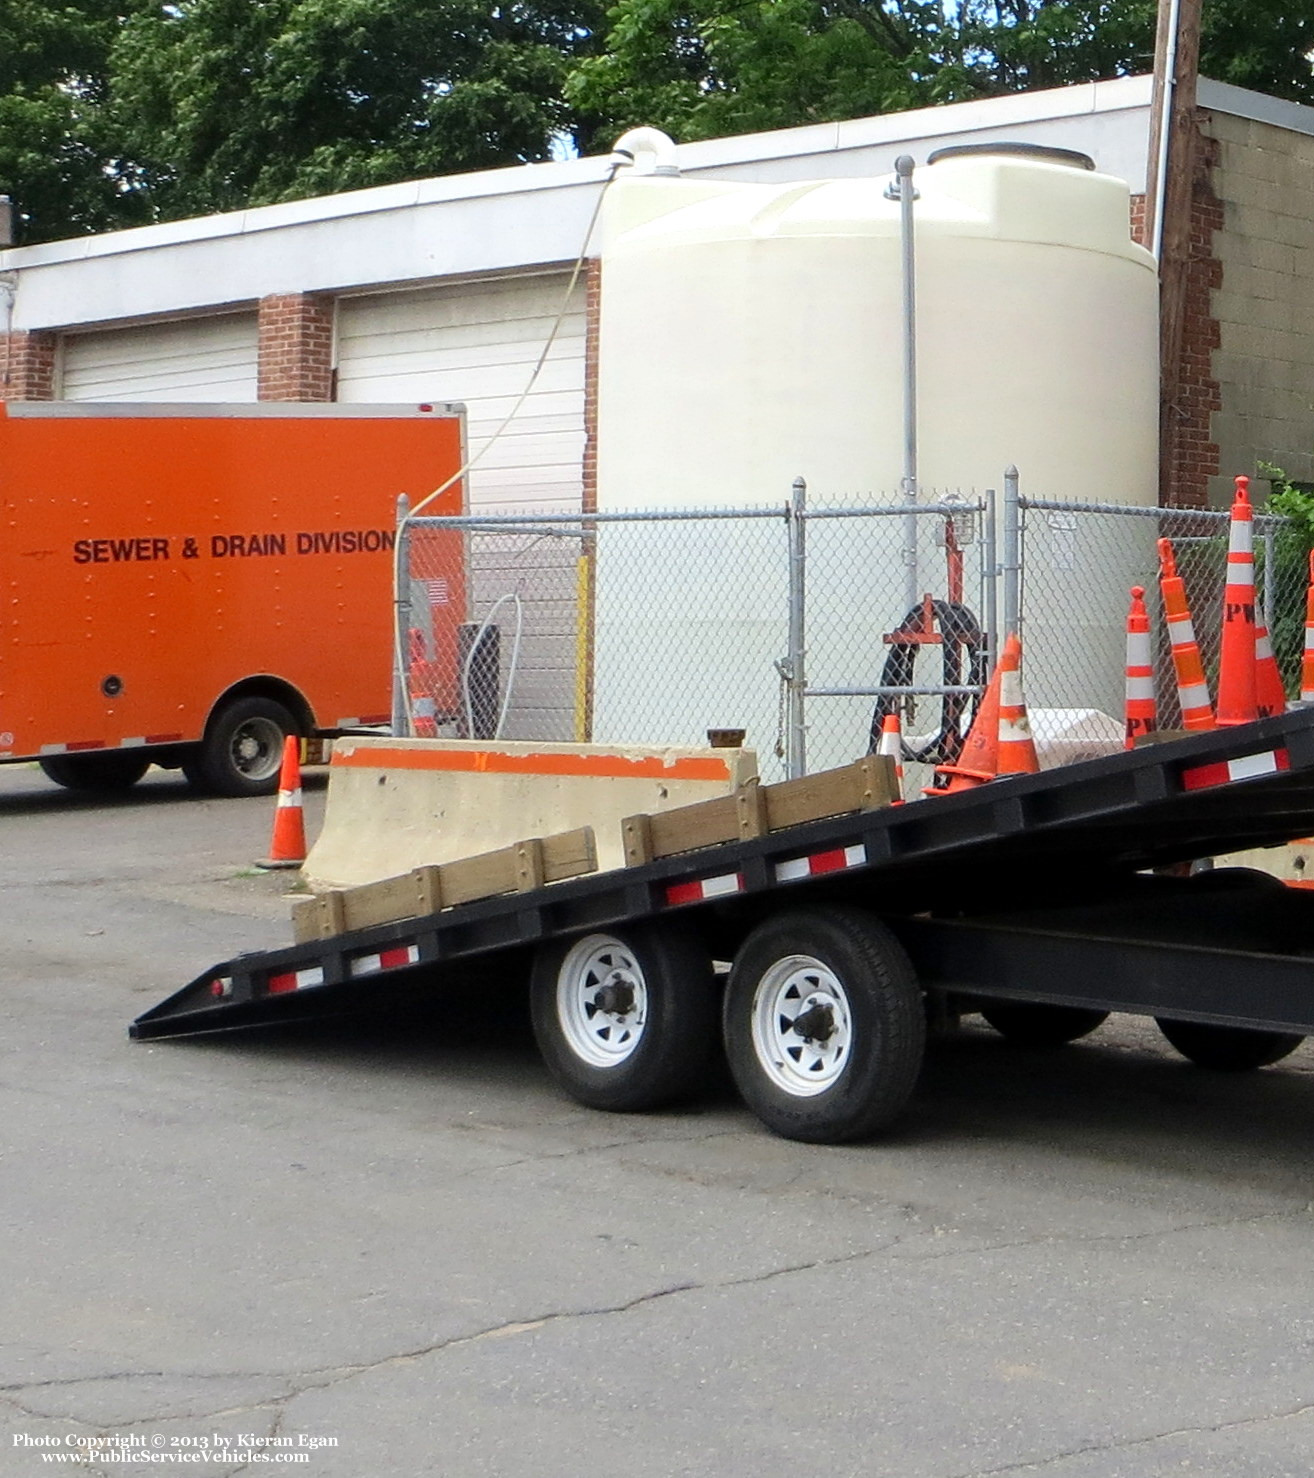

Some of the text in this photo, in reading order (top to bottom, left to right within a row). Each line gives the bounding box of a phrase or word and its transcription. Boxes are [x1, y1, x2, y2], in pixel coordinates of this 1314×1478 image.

[74, 530, 396, 563] SEWER & DRAIN DIVISION
